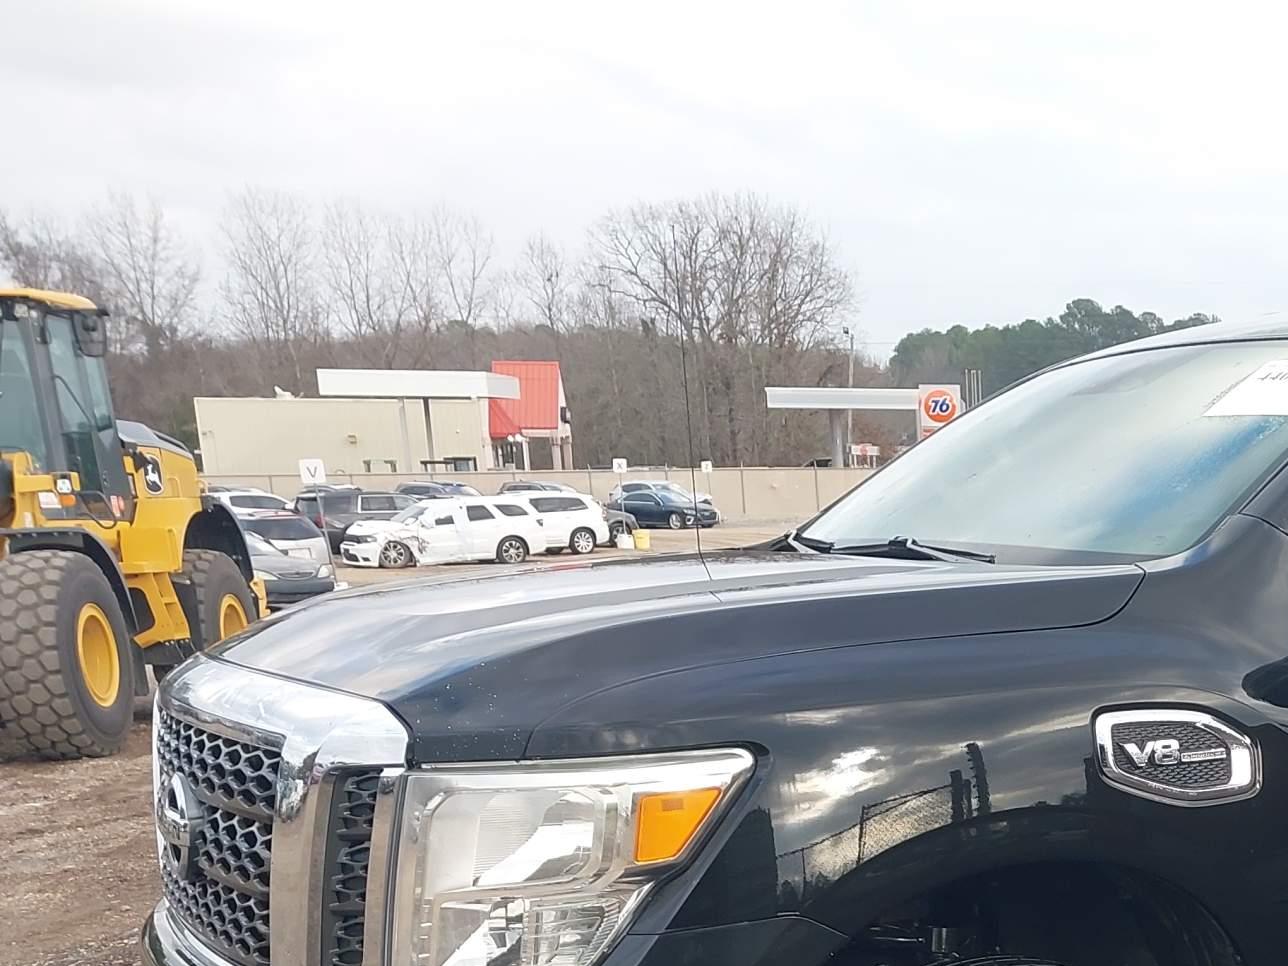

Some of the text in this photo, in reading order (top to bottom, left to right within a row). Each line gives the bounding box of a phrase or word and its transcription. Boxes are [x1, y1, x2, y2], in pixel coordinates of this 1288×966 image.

[929, 397, 951, 414] 76
[306, 466, 318, 478] V
[1120, 739, 1180, 766] V8
